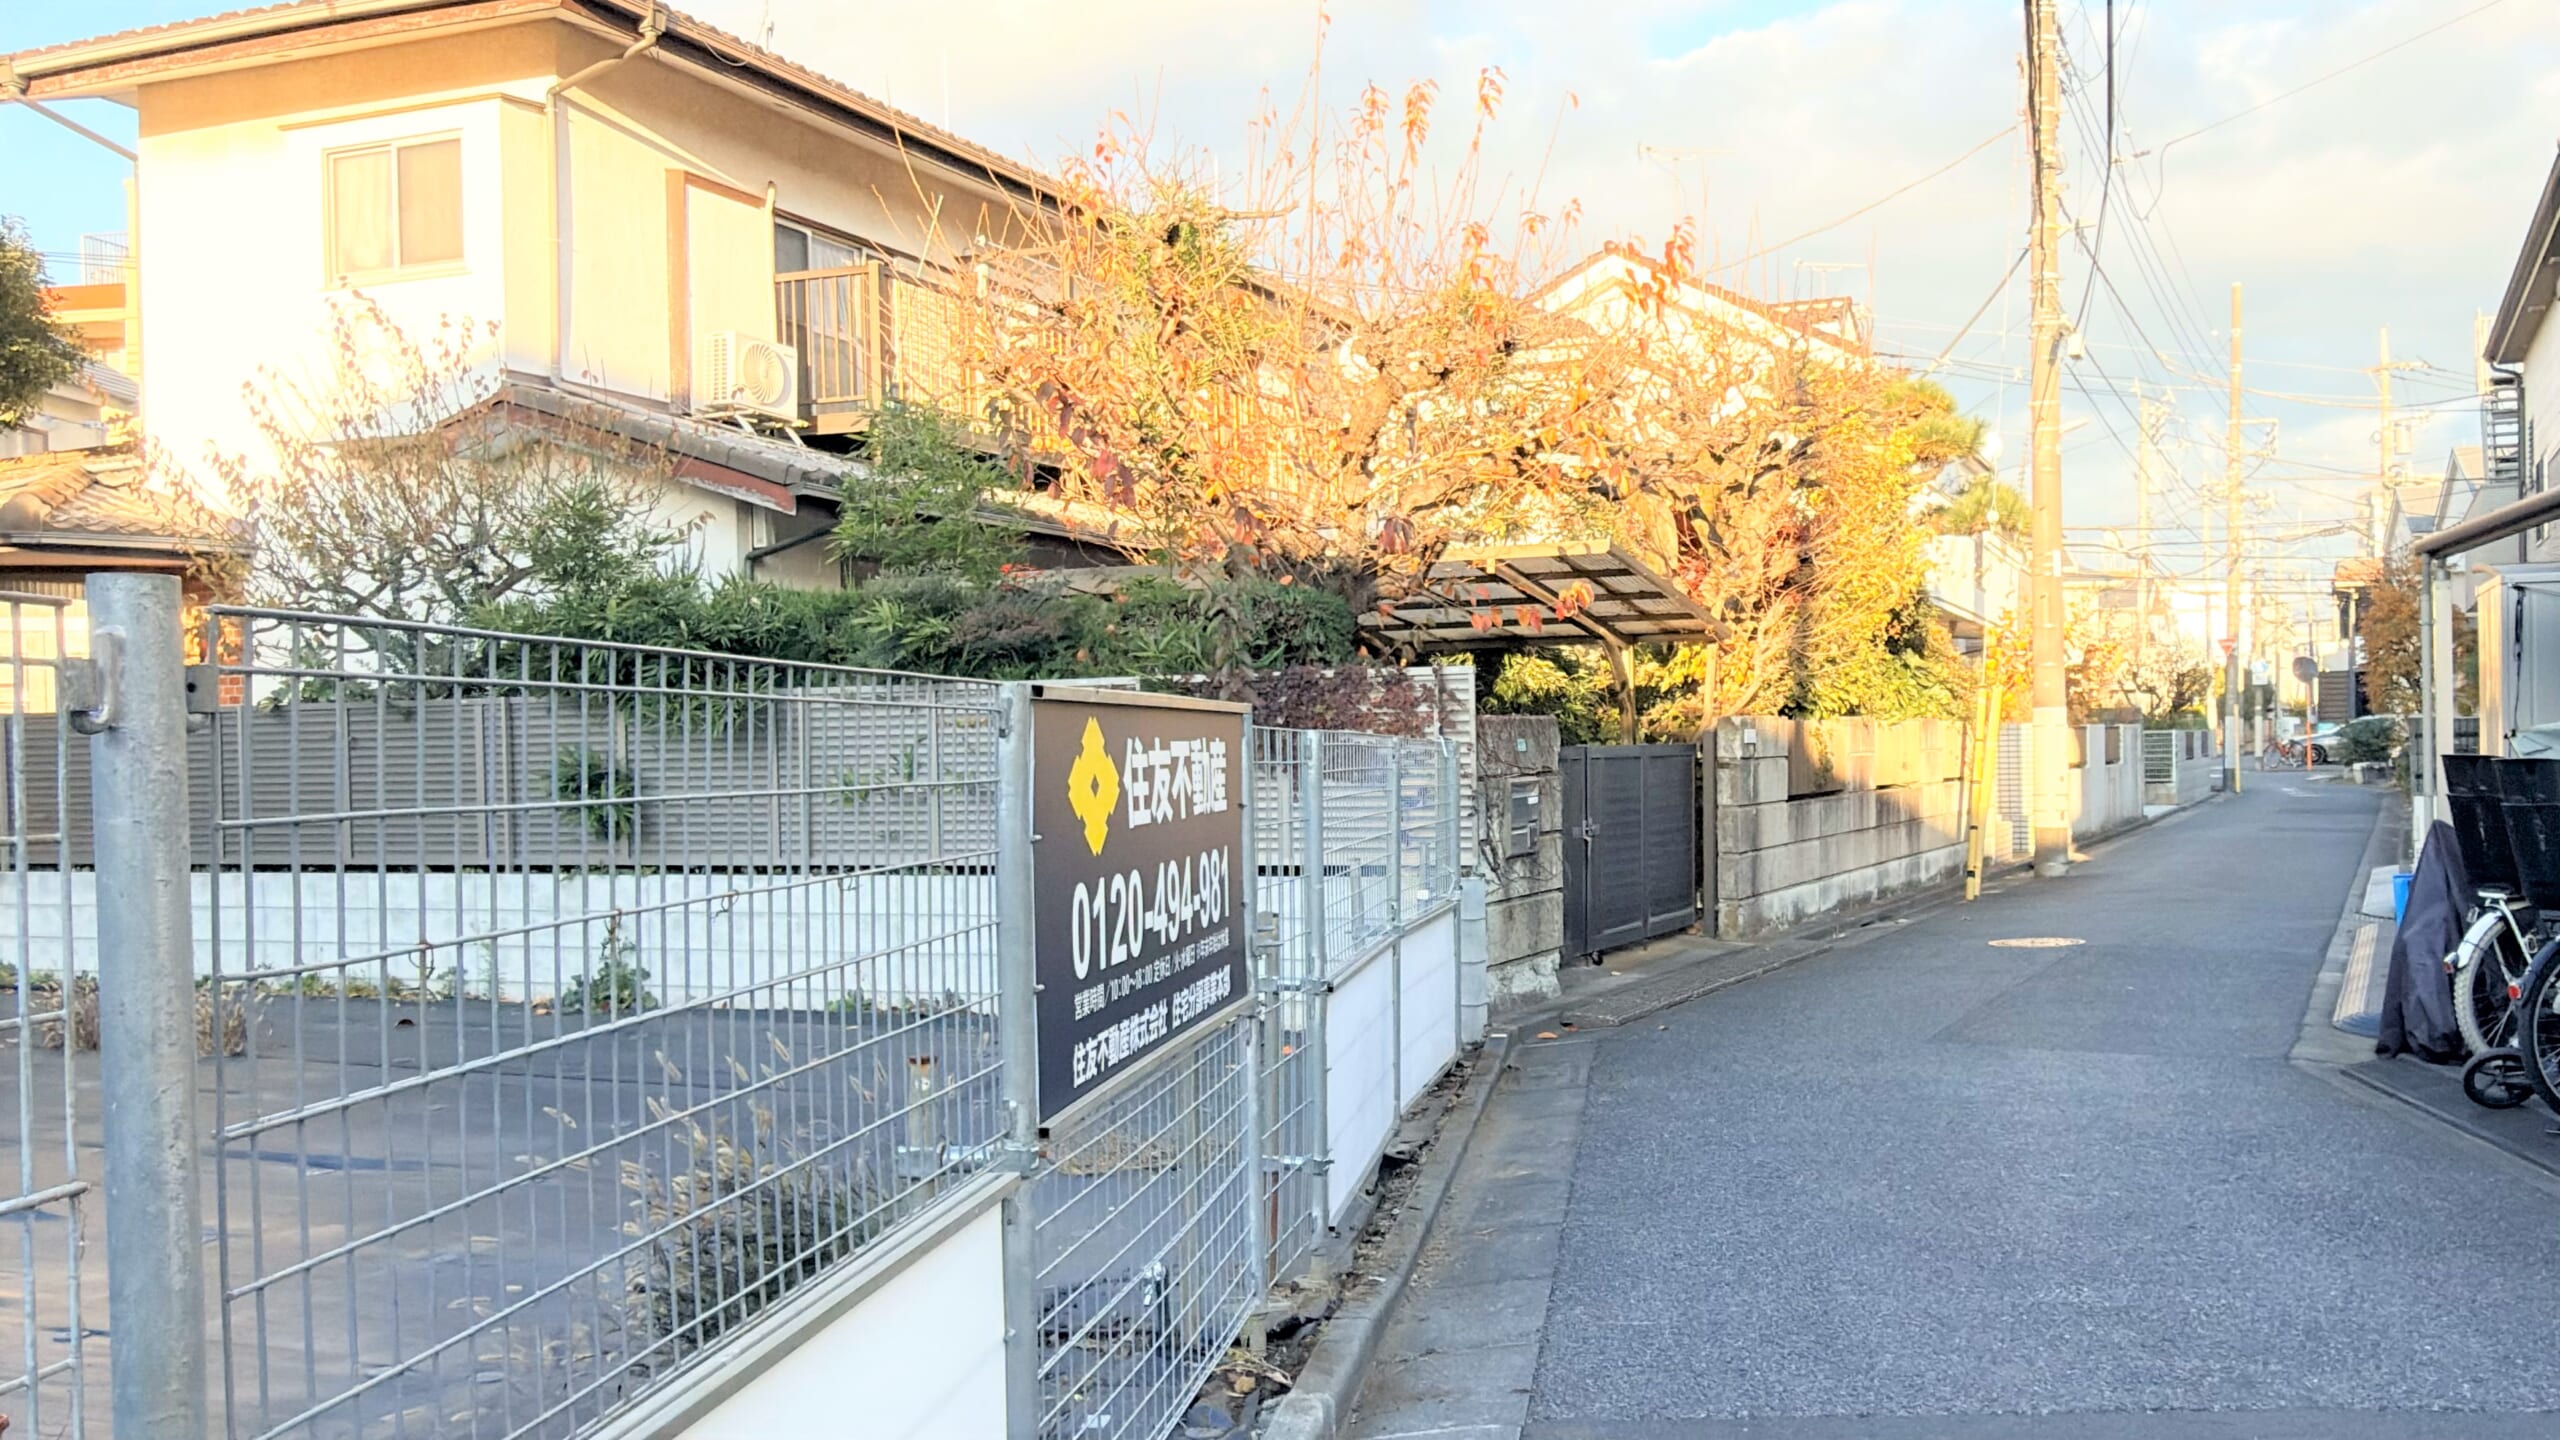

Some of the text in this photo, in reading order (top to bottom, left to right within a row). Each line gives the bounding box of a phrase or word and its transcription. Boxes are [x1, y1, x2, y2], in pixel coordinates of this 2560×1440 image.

[1123, 737, 1228, 830] 住友不動産
[1072, 845, 1229, 980] 0120-494-981
[1073, 998, 1168, 1089] 住友不動産株式会社
